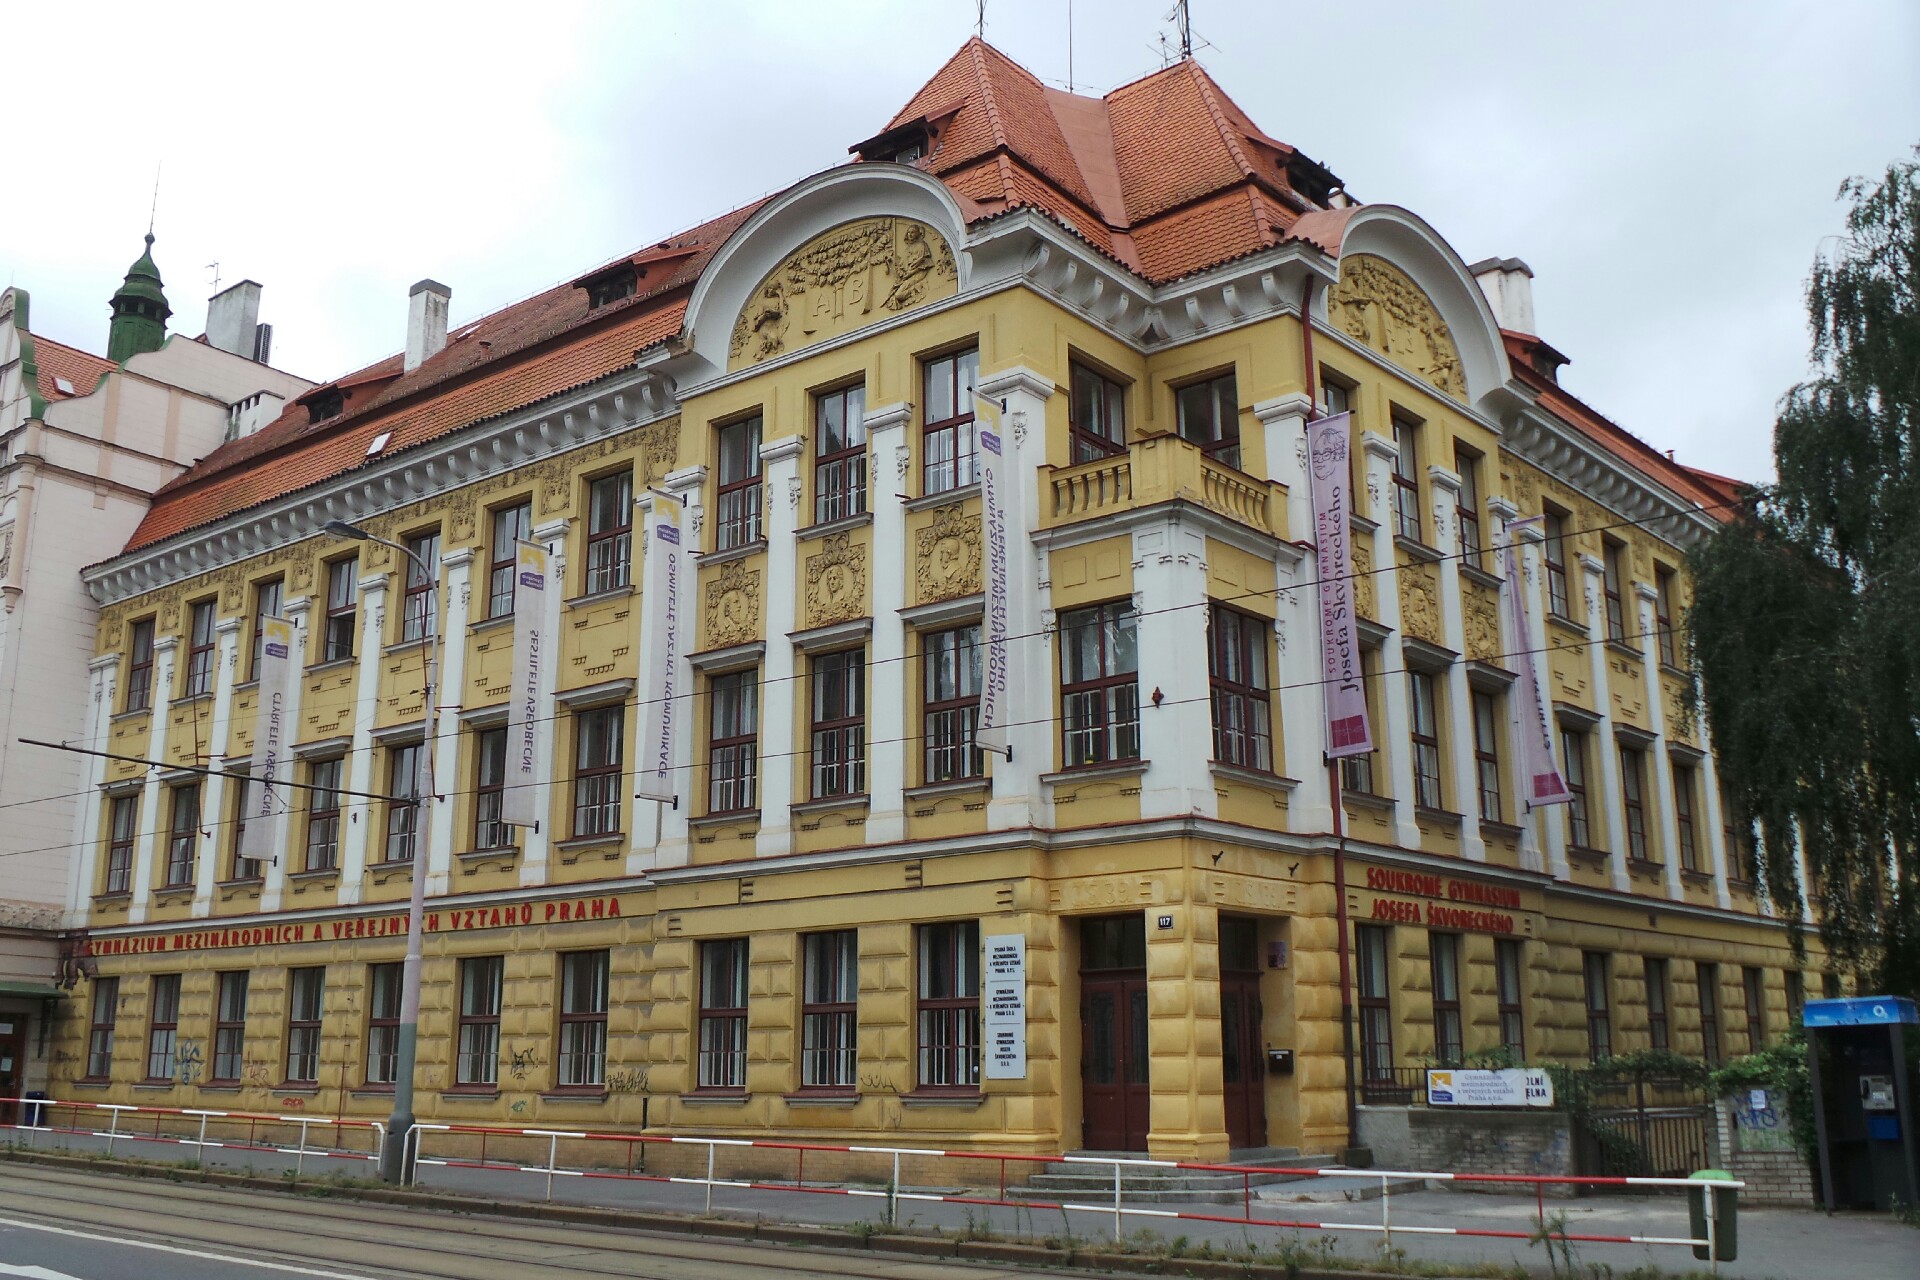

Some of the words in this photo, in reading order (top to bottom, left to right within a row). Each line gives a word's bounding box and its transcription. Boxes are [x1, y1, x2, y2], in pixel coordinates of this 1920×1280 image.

[1339, 625, 1359, 694] Josefa
[1366, 867, 1443, 897] SOUKROMÉ
[1448, 880, 1521, 908] GYMNASIUM
[173, 924, 304, 950] MEZINÁRODNÍCH
[313, 923, 322, 940] A
[451, 902, 532, 929] VZTAHŮ
[545, 897, 621, 921] PRAHA
[1160, 917, 1171, 926] 117
[1371, 898, 1421, 923] JOSEFA
[1427, 901, 1514, 934] ŠKVORECKÉHO
